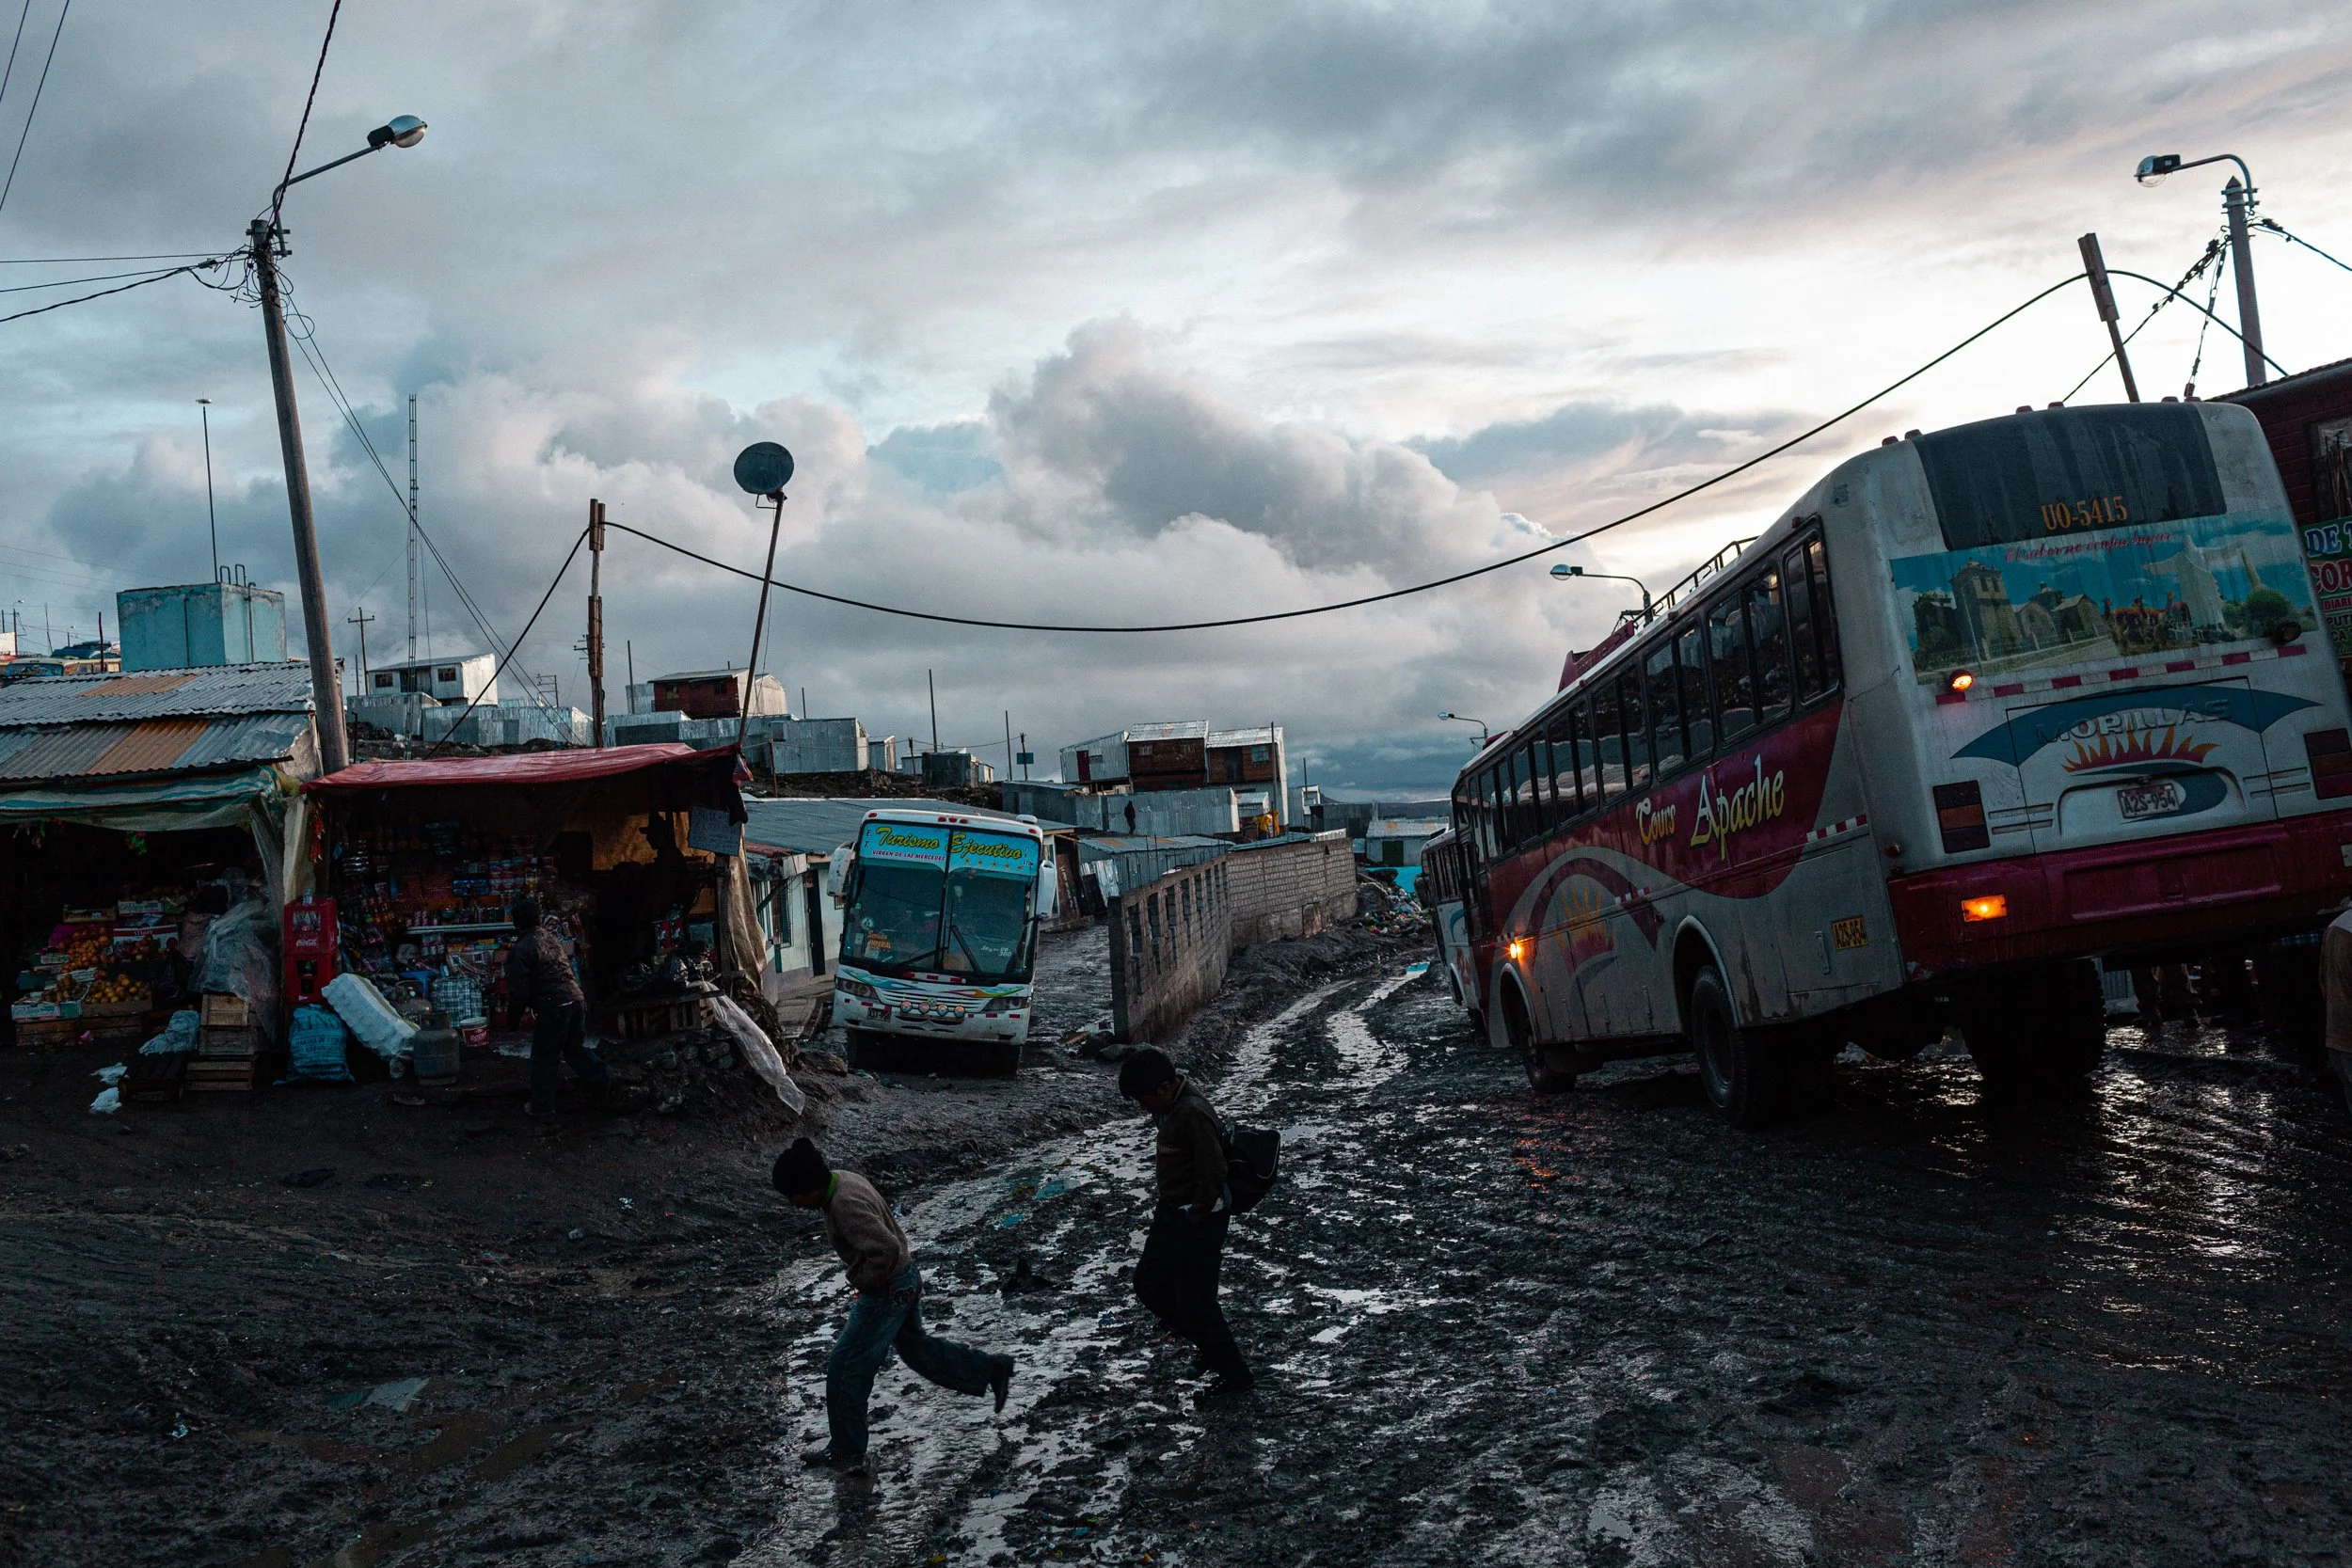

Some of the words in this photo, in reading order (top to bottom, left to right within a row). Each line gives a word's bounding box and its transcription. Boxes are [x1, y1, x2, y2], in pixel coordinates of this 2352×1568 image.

[2304, 524, 2343, 558] DE
[2326, 613, 2352, 627] PUT
[2035, 698, 2233, 744] MORILLAS
[1690, 752, 1785, 863] Apache
[876, 826, 940, 849] Turismo
[945, 833, 1023, 860] Ejecutivo
